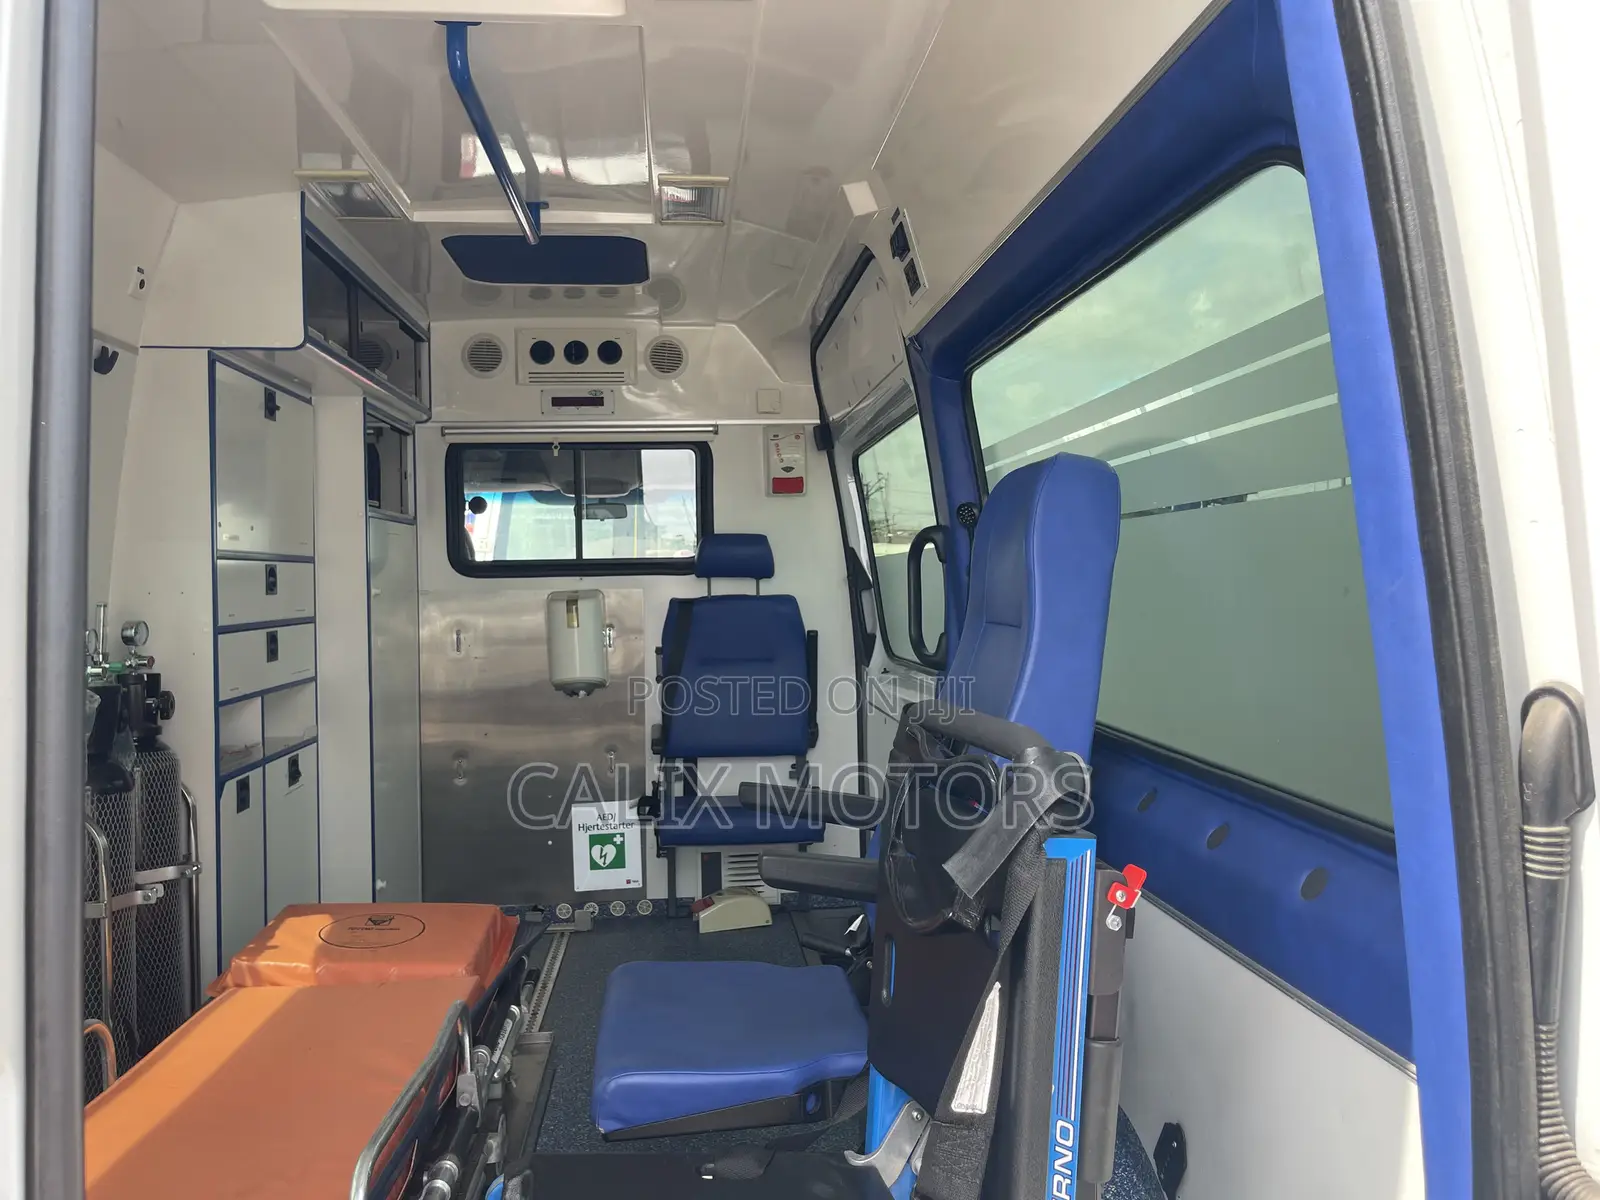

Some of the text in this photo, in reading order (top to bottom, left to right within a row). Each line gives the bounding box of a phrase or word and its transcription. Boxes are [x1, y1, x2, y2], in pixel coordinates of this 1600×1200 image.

[596, 813, 616, 822] AED/
[578, 822, 634, 833] Hjertestarter
[1052, 1119, 1075, 1200] RNO
